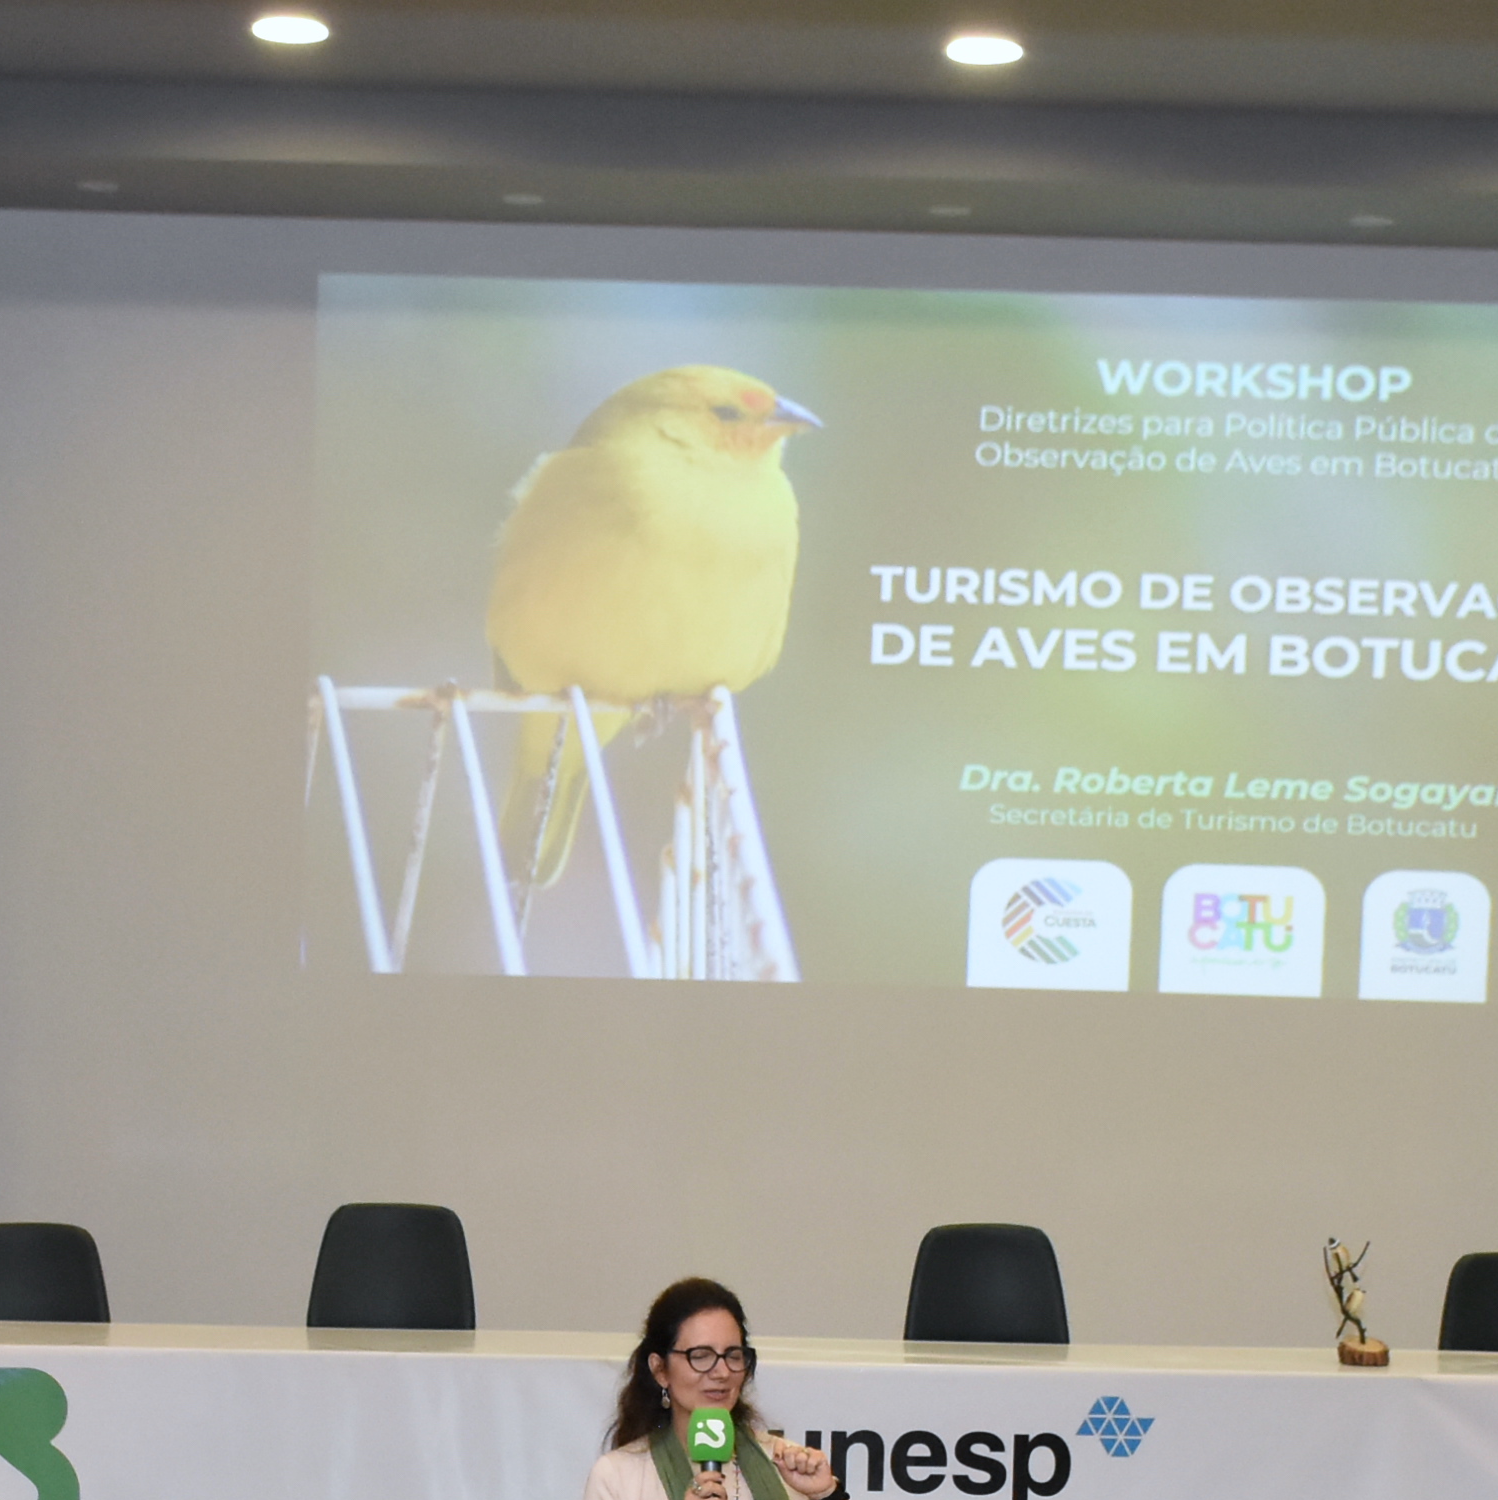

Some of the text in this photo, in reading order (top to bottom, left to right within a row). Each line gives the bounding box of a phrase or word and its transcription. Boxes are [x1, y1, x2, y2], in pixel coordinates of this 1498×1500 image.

[1097, 358, 1413, 402] WORKSHOP
[979, 404, 1134, 435] Diretrizes
[1142, 414, 1215, 441] para
[1225, 411, 1344, 441] Política
[1355, 414, 1476, 445] Pública
[975, 441, 1167, 477] Observação
[1175, 447, 1217, 473] de
[1224, 449, 1302, 476] Aves
[1310, 454, 1364, 478] em
[870, 565, 1123, 612] TURISMO
[1140, 572, 1215, 612] DE
[870, 623, 955, 667] DE
[971, 626, 1137, 673] AVES
[1156, 631, 1248, 675] EM
[959, 763, 1042, 793] Dra.
[1053, 766, 1215, 797] Roberta
[1224, 772, 1335, 801] Leme
[989, 803, 1478, 839] Secretária de Turismo de Botucatu
